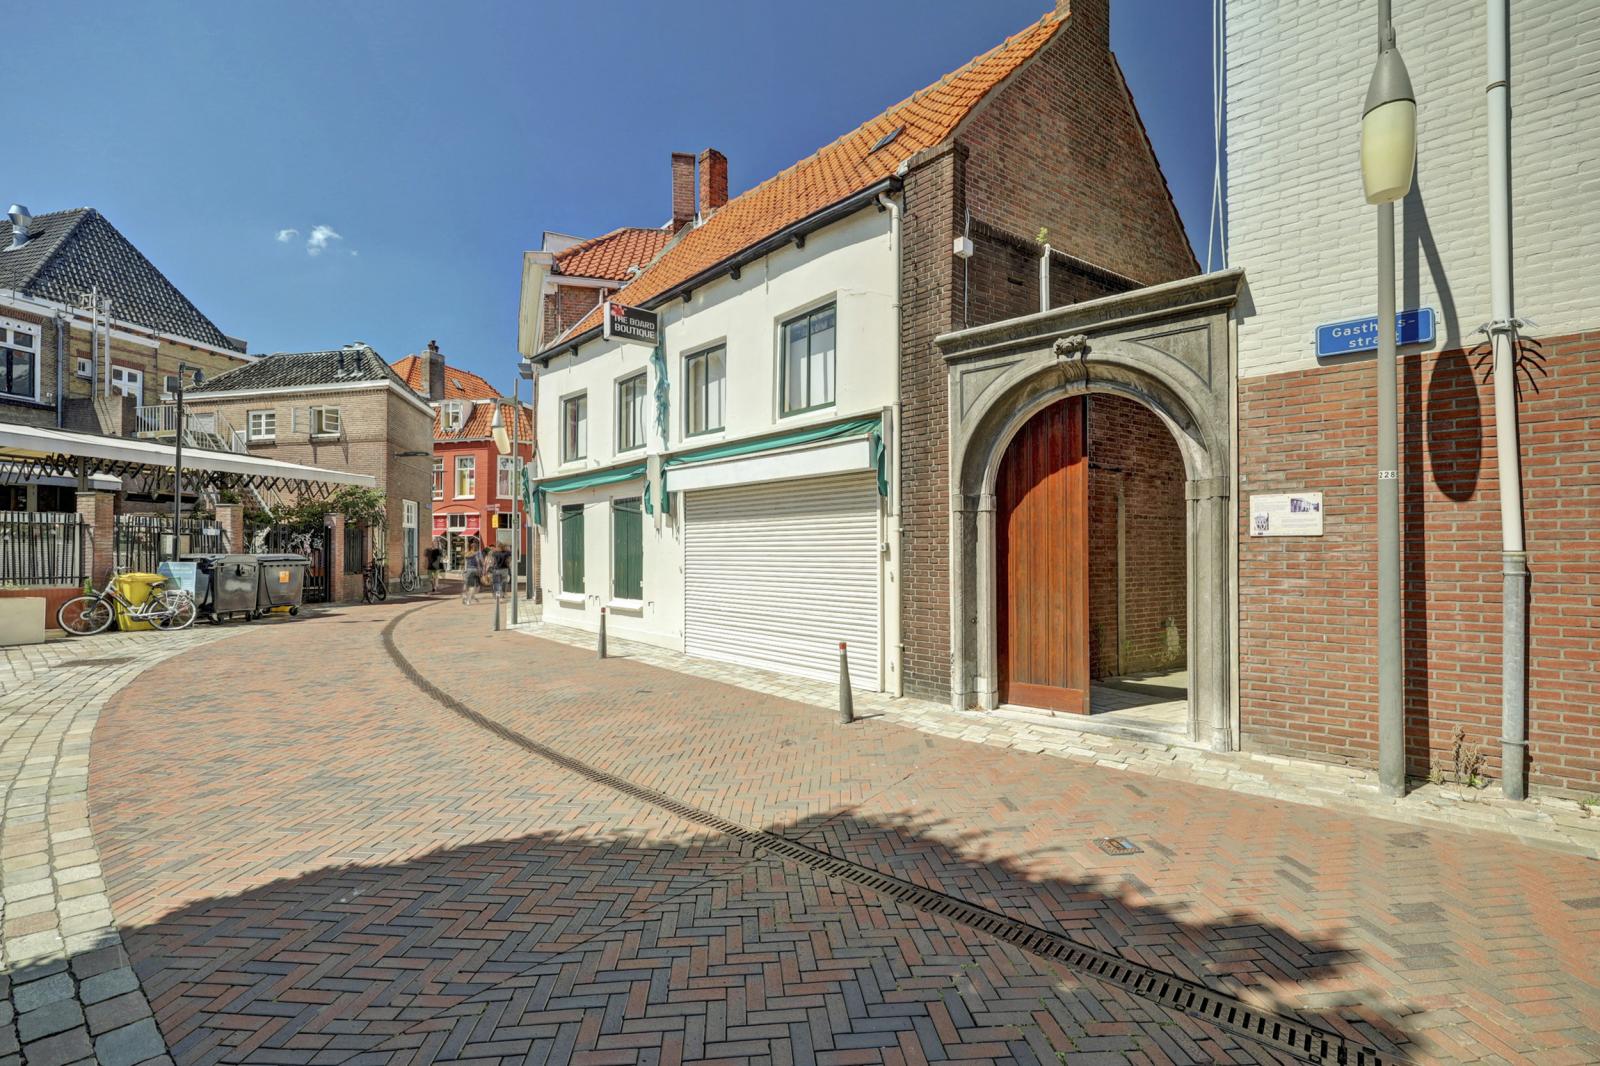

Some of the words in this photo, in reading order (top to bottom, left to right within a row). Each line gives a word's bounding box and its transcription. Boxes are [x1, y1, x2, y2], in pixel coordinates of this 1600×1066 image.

[614, 316, 628, 324] THE
[629, 317, 655, 329] BOARD
[614, 322, 655, 339] BOUTIQUE
[1332, 319, 1416, 337] Gasths-
[1348, 331, 1400, 348] strat
